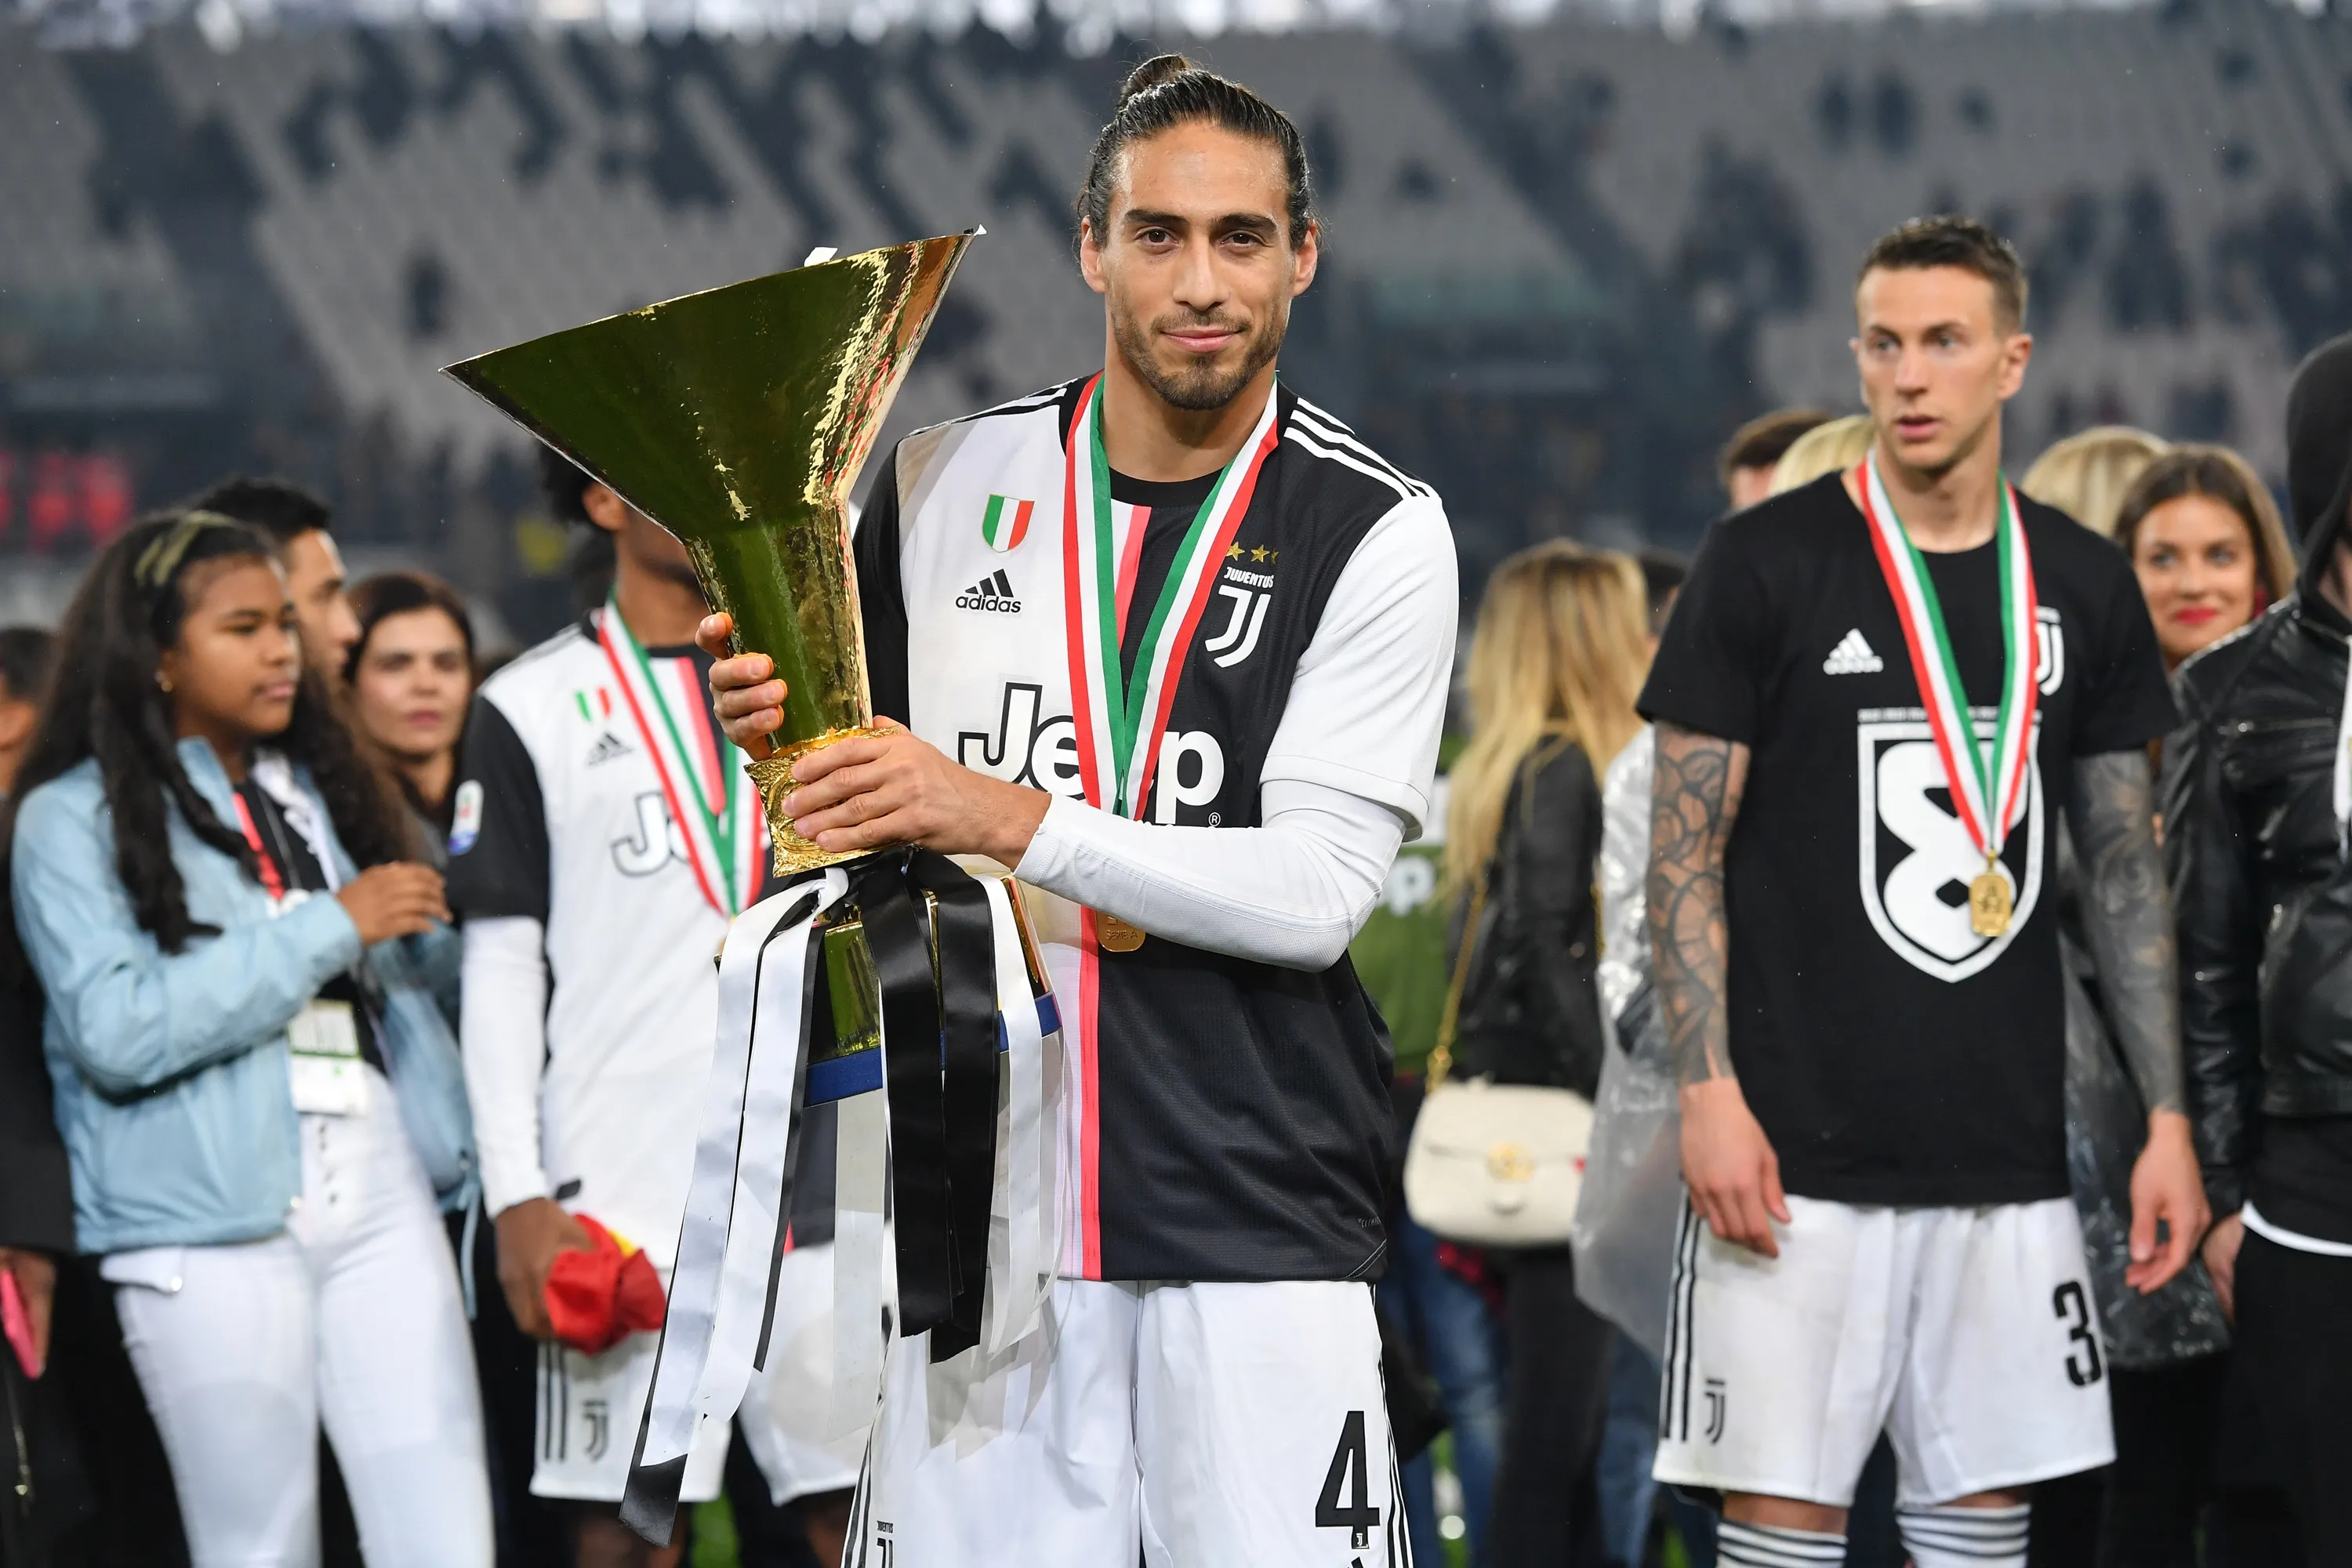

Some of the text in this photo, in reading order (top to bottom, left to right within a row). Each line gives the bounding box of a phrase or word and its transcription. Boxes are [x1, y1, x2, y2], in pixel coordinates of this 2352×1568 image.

[955, 594, 1022, 613] adidas
[1223, 566, 1275, 589] JUVENTUS
[958, 681, 1225, 825] Jep
[1105, 929, 1138, 941] SERIE A
[2053, 1279, 2102, 1387] 3
[1316, 1410, 1380, 1549] 4
